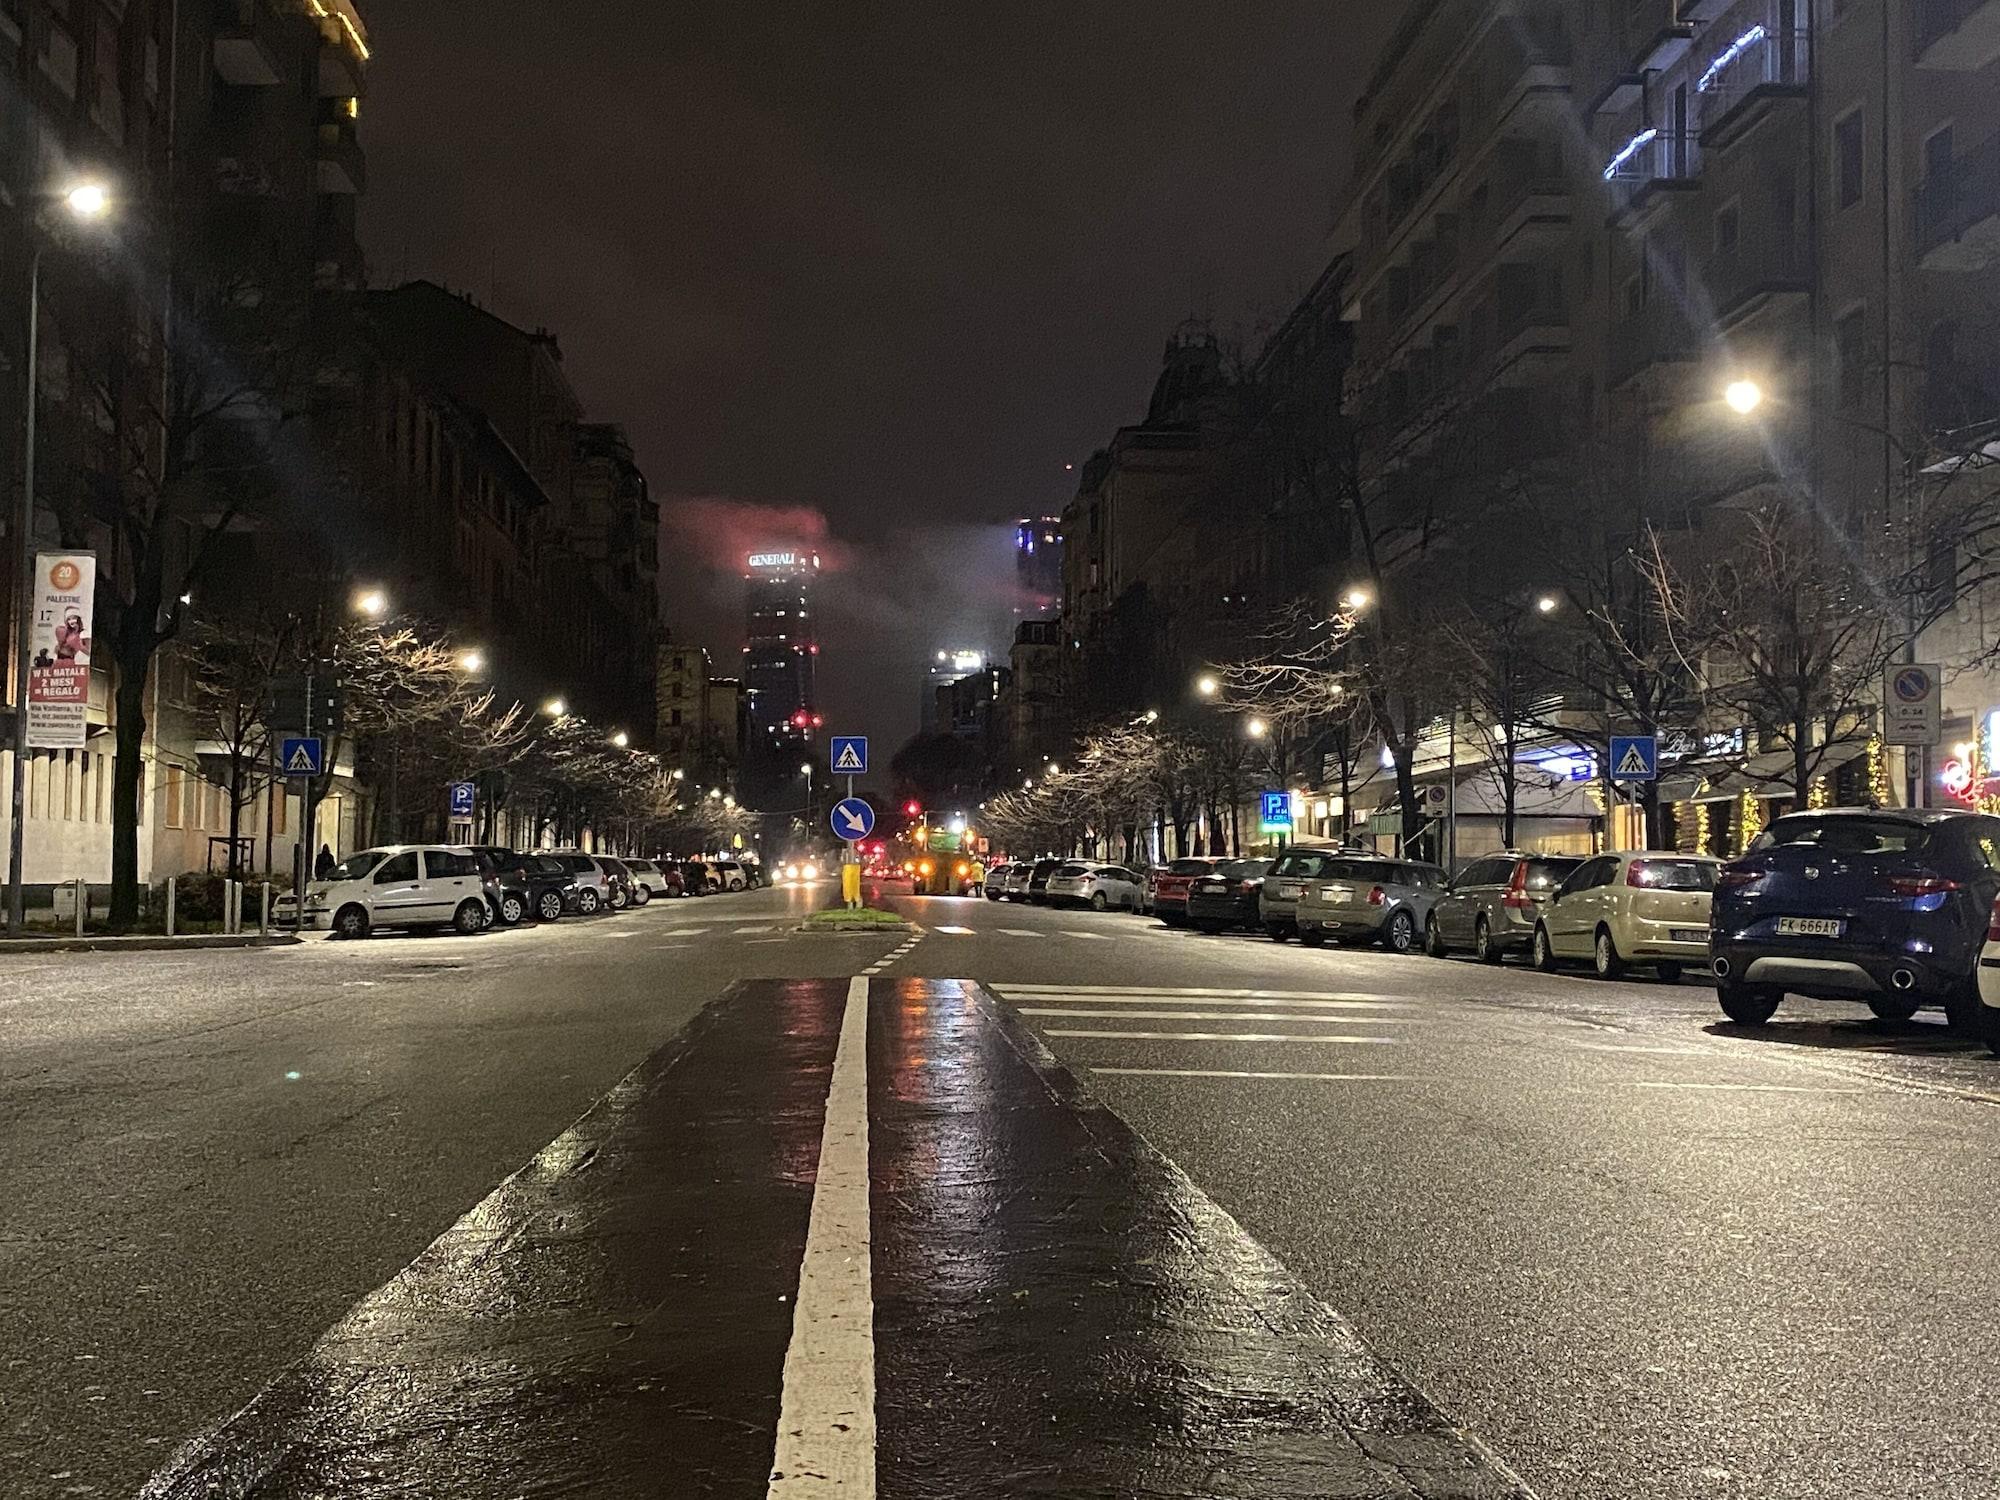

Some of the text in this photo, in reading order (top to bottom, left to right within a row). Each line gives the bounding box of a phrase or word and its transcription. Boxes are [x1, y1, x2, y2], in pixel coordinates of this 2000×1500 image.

[749, 553, 795, 567] GENERALI
[59, 566, 72, 578] 20
[46, 595, 81, 604] PALESTRE
[40, 610, 54, 621] 17
[53, 667, 86, 677] NATALE
[41, 677, 75, 688] 2 MESI
[43, 686, 81, 697] REGALO
[1780, 919, 1838, 934] FK 666AR
